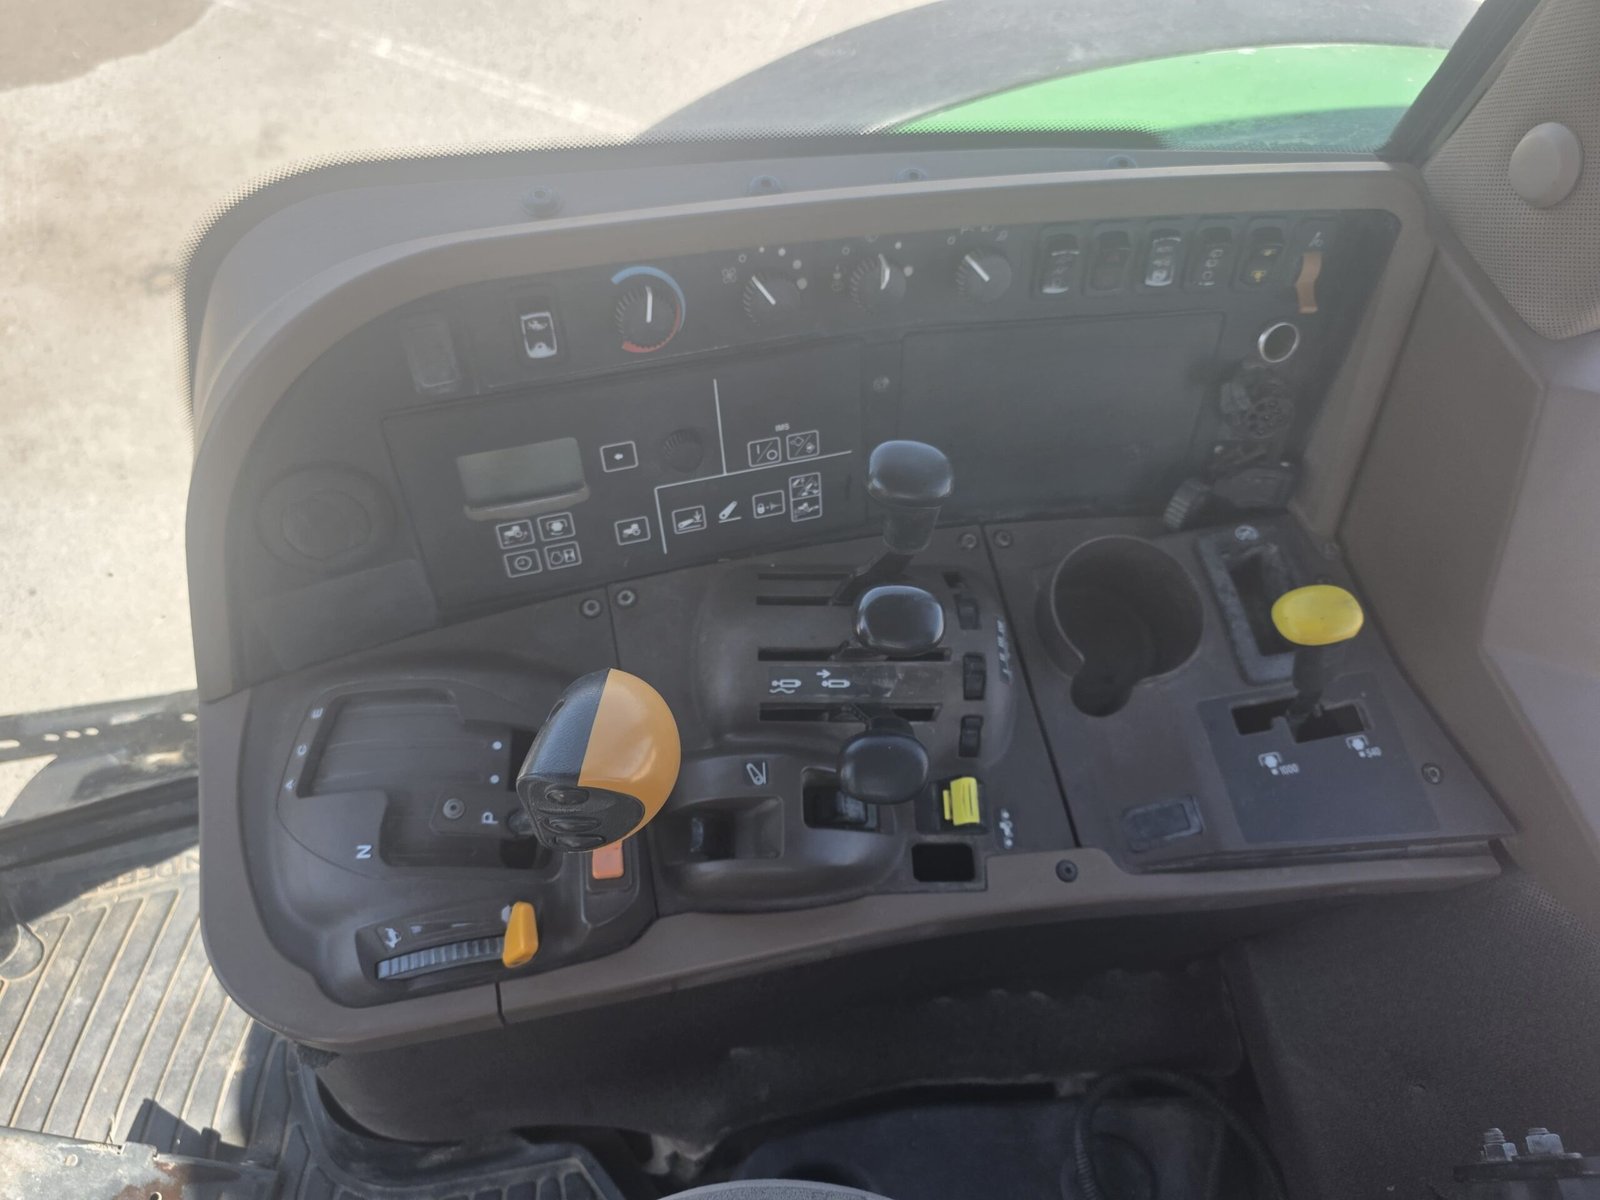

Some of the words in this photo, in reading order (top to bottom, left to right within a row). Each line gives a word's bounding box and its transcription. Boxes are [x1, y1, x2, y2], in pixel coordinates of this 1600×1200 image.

[1365, 747, 1382, 758] 540
[1279, 763, 1299, 775] 1000
[482, 812, 499, 825] P
[356, 845, 372, 859] N
